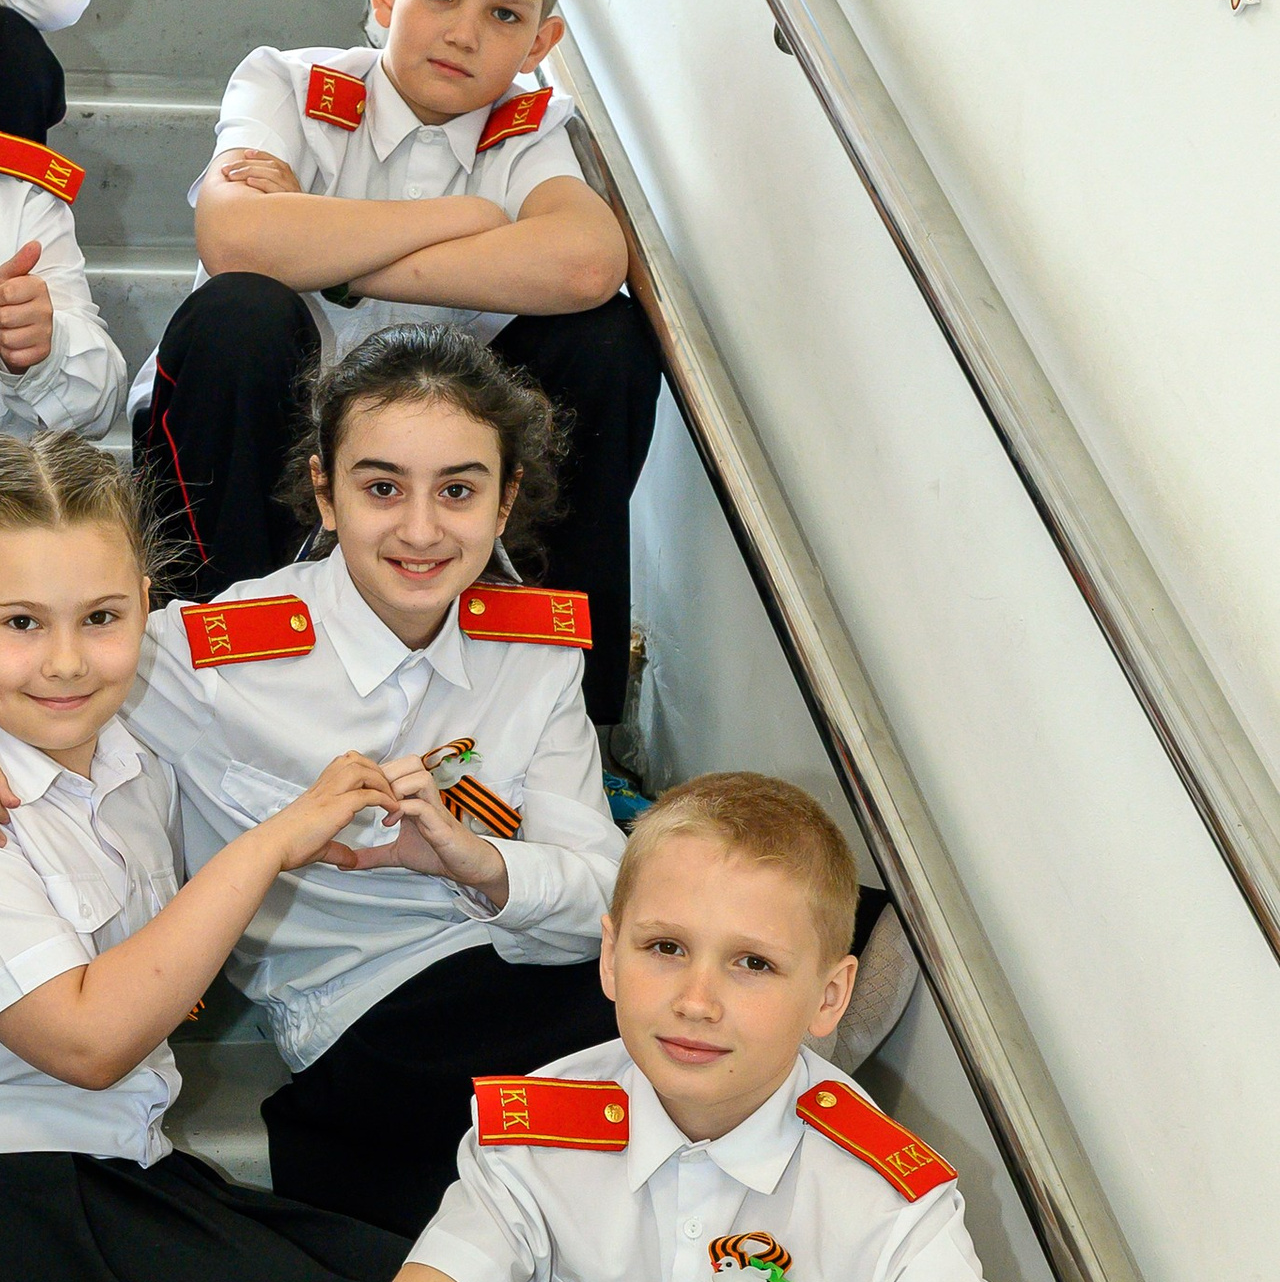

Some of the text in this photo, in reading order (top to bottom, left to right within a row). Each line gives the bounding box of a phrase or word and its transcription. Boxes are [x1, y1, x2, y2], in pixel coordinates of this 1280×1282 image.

[321, 77, 335, 112] КК
[511, 97, 536, 126] КК
[44, 159, 73, 188] КК
[548, 597, 576, 635] КК
[202, 613, 232, 655] КК
[499, 1087, 530, 1131] КК
[885, 1144, 934, 1178] КК
